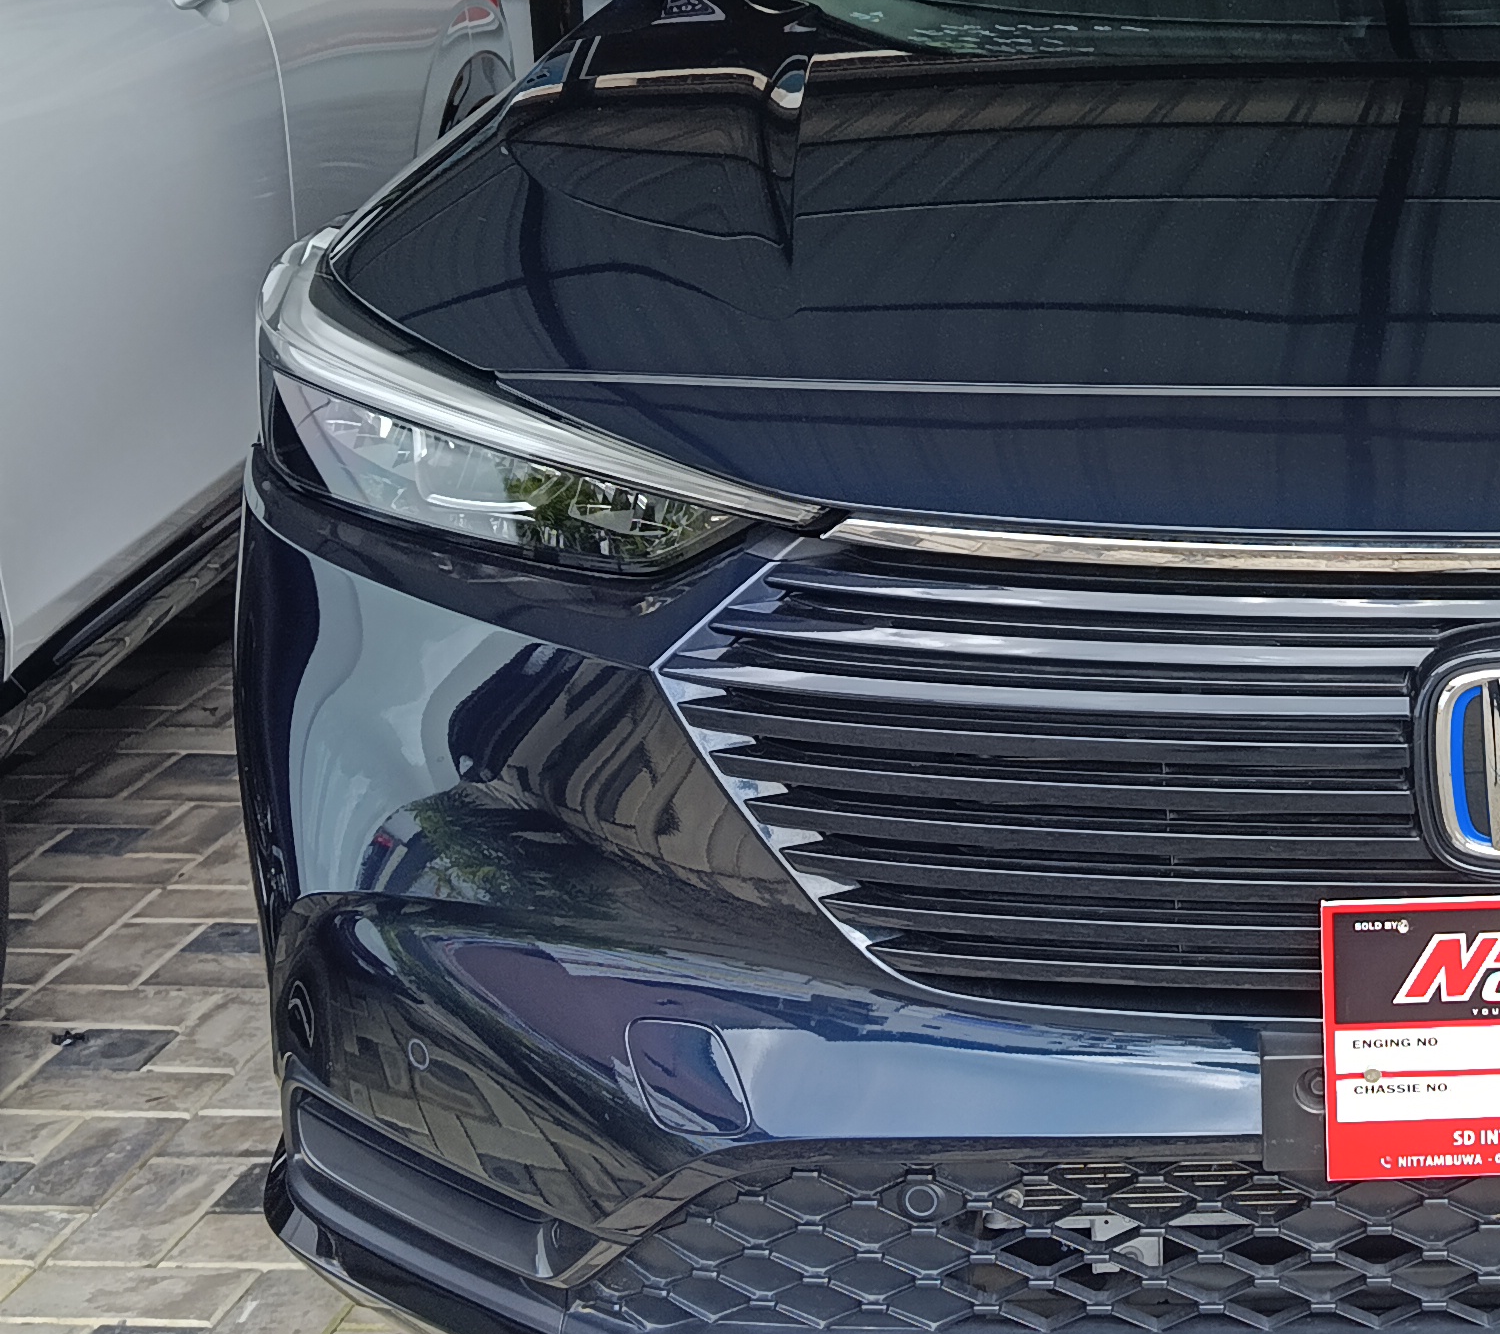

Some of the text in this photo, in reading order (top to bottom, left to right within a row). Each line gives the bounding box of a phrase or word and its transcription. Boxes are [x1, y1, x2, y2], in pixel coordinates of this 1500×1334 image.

[1354, 921, 1382, 932] SOLD
[1352, 1037, 1438, 1050] ENGING NO
[1353, 1083, 1421, 1095] CHASSIE
[1453, 1130, 1476, 1146] SD
[1397, 1153, 1483, 1168] NITTAMBUWA
